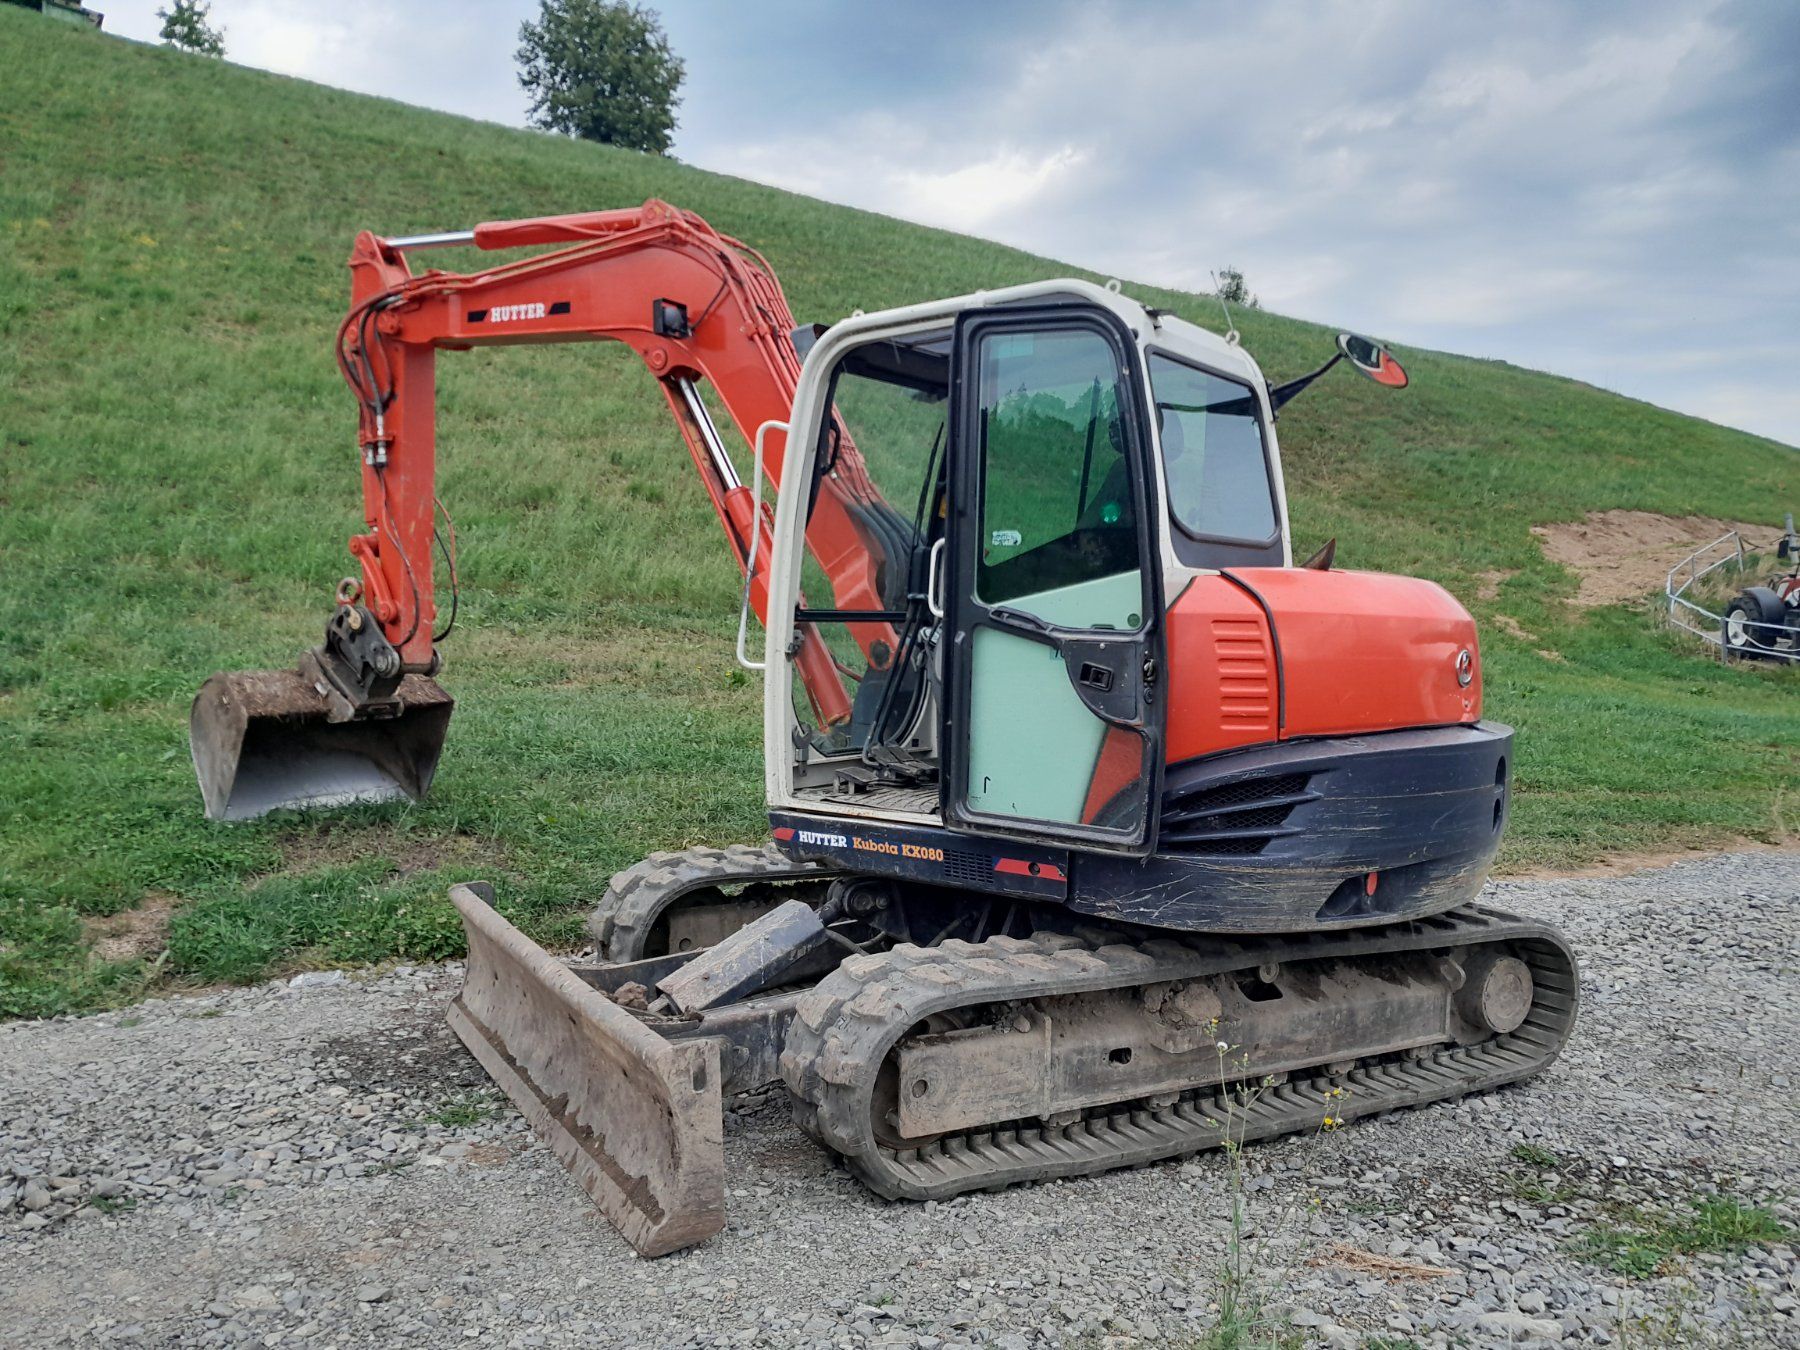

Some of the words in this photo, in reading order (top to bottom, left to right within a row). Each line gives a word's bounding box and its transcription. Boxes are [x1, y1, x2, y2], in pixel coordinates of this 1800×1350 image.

[490, 302, 545, 323] HUTTER
[799, 830, 847, 848] HUTTER
[852, 836, 899, 855] Kubota
[901, 843, 944, 862] KX080
